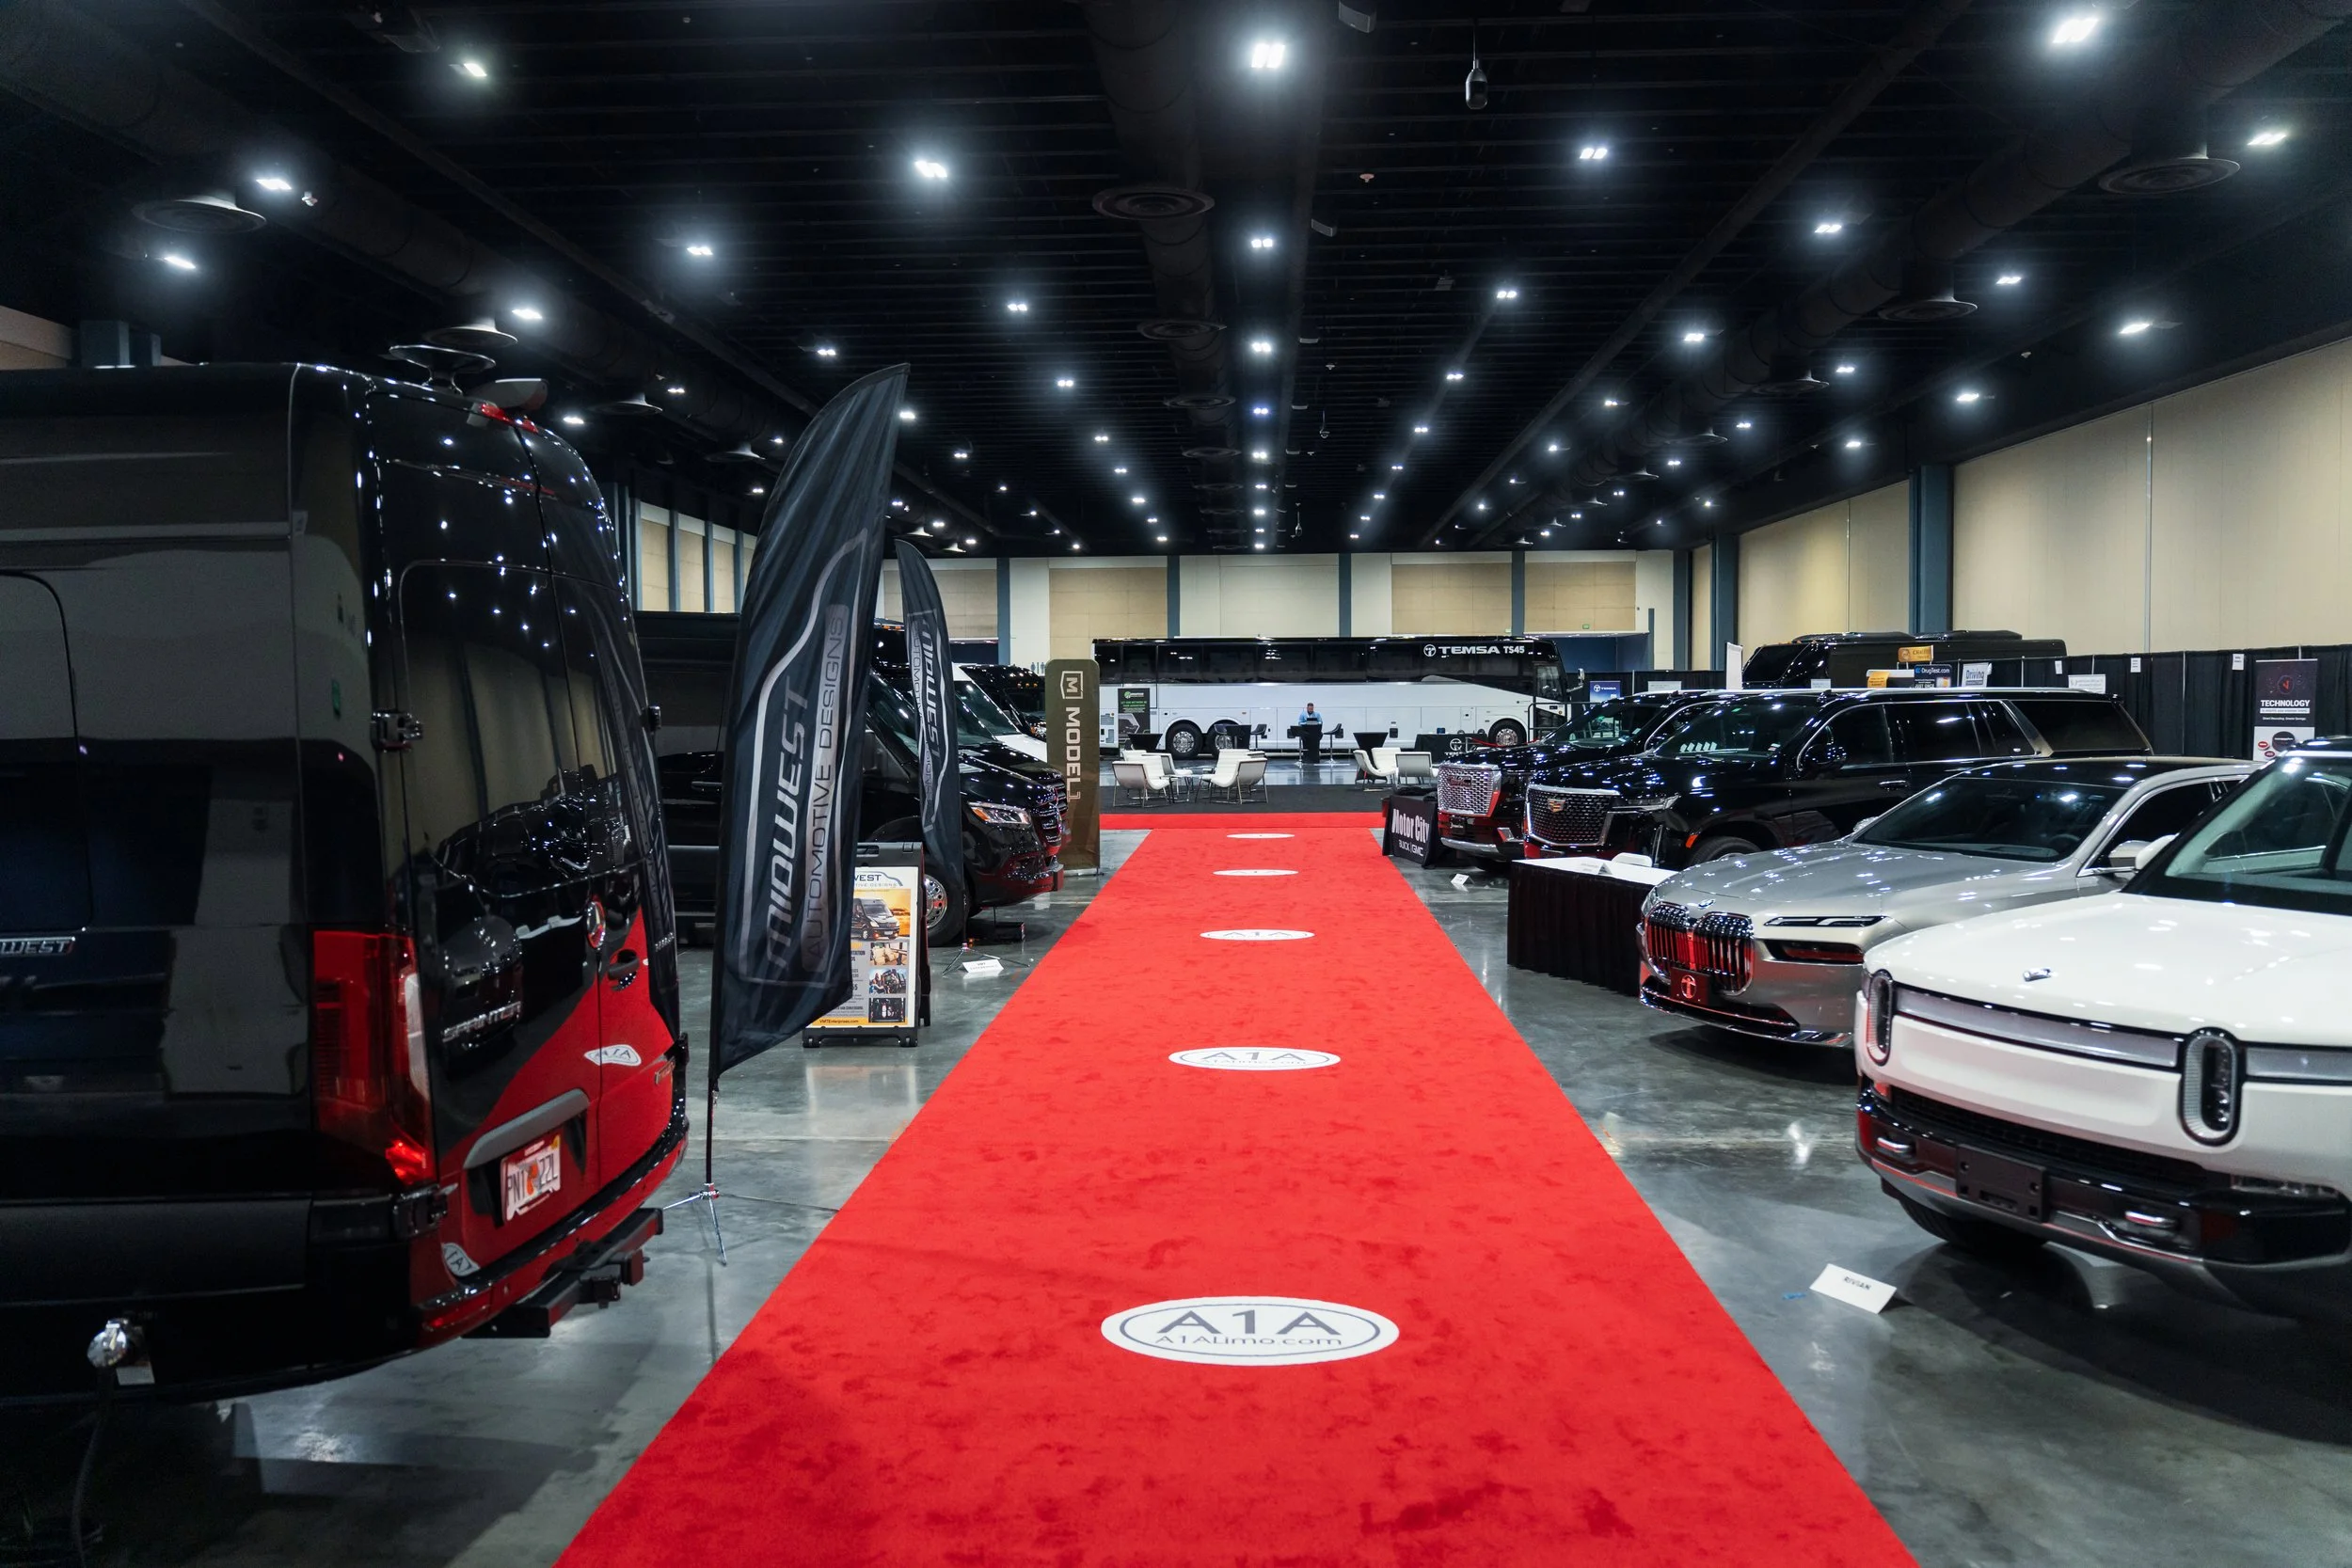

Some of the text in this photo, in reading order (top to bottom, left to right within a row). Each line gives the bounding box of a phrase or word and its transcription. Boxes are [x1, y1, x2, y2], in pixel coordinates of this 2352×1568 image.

[1438, 645, 1525, 655] TEMSA TS45
[807, 616, 844, 959] AUTOMOTIVE DESIGNS
[765, 676, 808, 972] MIDWEST
[1391, 808, 1430, 844] Motor City
[1412, 845, 1423, 857] GMC
[1202, 1052, 1307, 1061] A1A
[1157, 1309, 1342, 1336] A1A
[1155, 1335, 1343, 1346] A1ALimo.com
